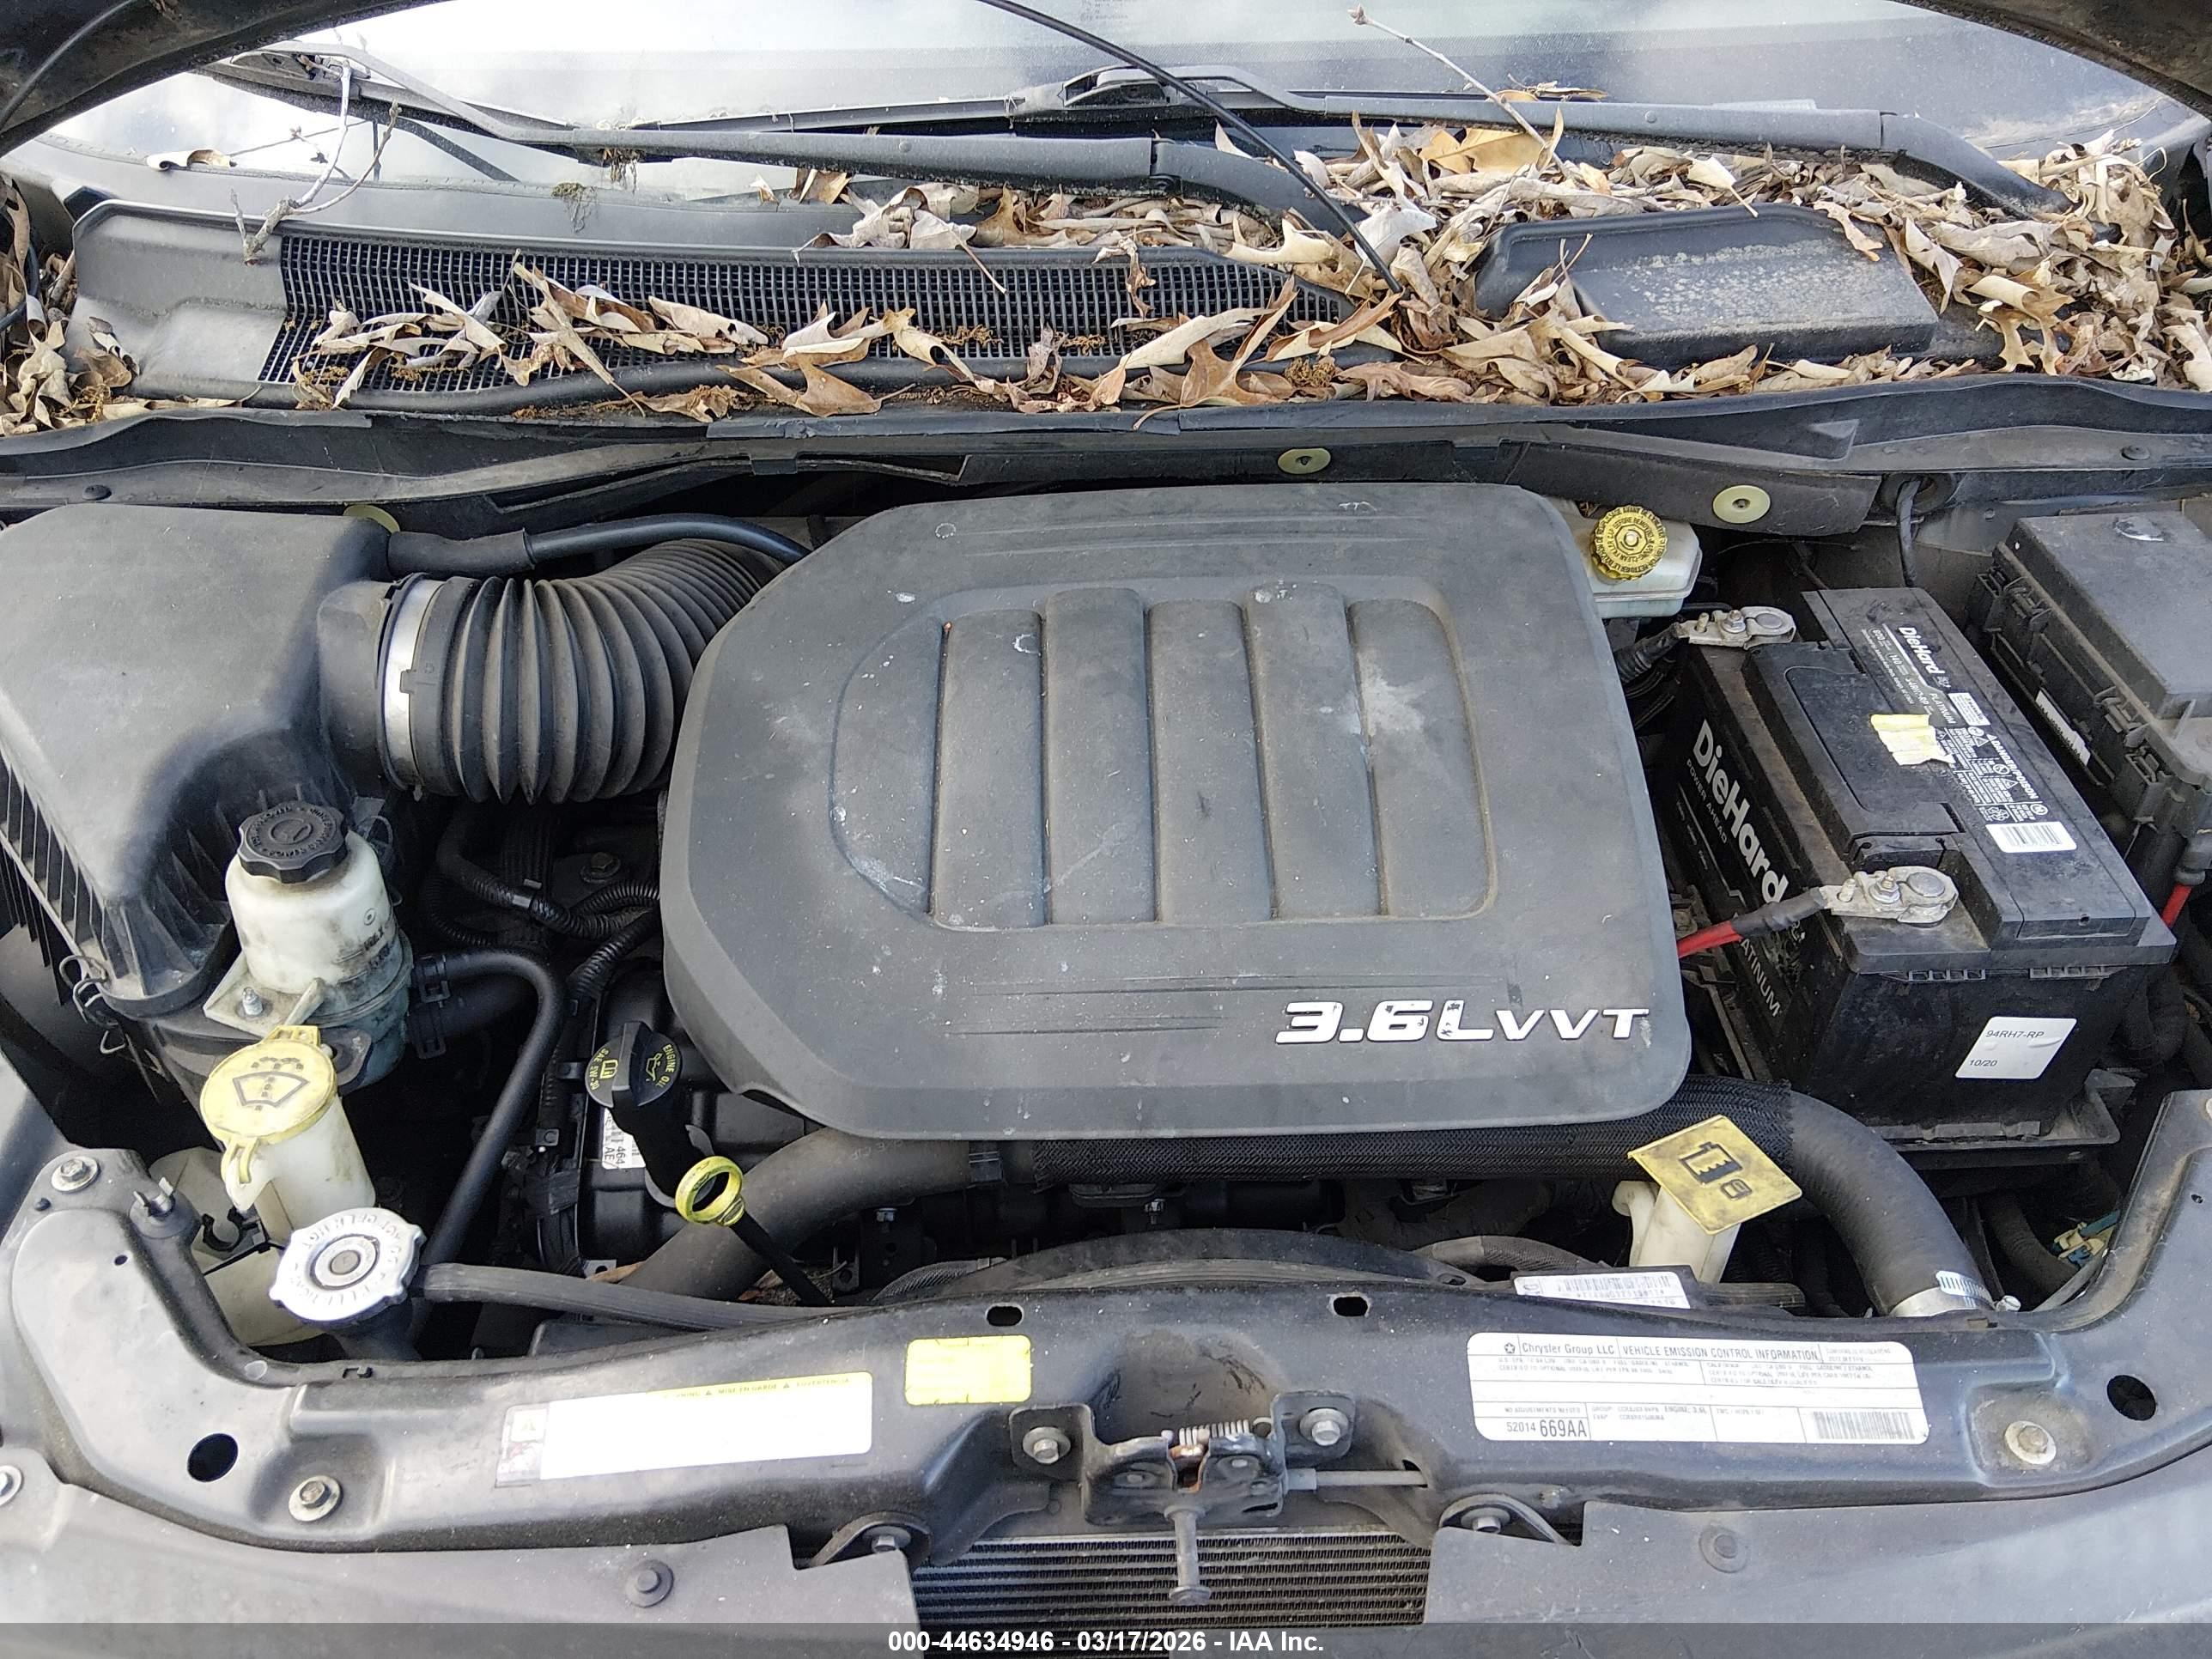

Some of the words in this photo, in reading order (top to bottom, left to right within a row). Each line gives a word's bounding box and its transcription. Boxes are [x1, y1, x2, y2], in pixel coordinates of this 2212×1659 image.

[1899, 627, 1946, 674] DieHard
[1929, 692, 1957, 724] PLATINUM
[1686, 758, 1707, 801] POWER
[1705, 802, 1728, 844] AHEAD
[1692, 719, 1790, 903] DieHard
[1985, 1030, 2045, 1039] 94RH7-RP
[593, 1048, 610, 1063] SAE
[662, 1043, 676, 1073] ENGINE
[1969, 1059, 1998, 1067] 10/20
[655, 1075, 670, 1088] OIL
[615, 1146, 626, 1164] 464
[1522, 1342, 1561, 1354] Chrysler
[1565, 1343, 1594, 1356] Group
[1596, 1345, 1615, 1354] LLC
[1623, 1346, 1661, 1356] VEHICLE
[1664, 1346, 1708, 1358] EMISSION
[1711, 1348, 1753, 1359] CONTROL
[1755, 1349, 1819, 1361] INFORMATION
[1506, 1421, 1536, 1432] 52014
[1539, 1419, 1588, 1437] 669AA
